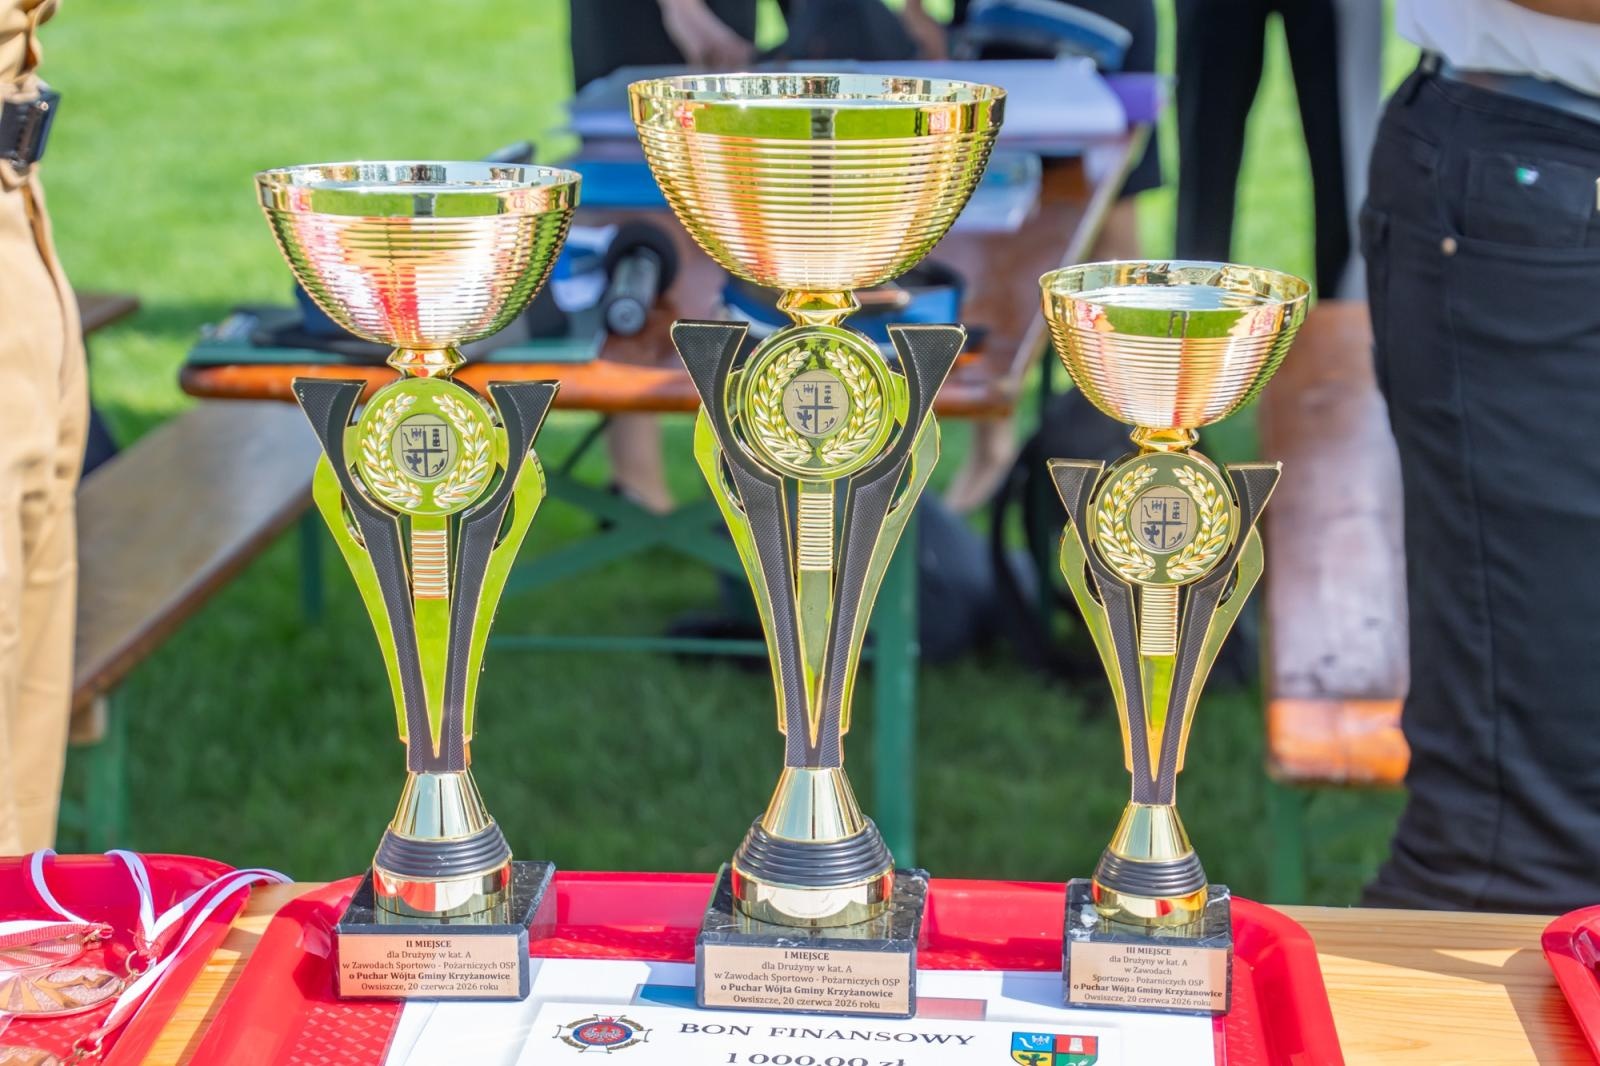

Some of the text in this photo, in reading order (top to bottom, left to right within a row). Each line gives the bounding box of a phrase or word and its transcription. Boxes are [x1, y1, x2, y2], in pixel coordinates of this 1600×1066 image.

[402, 951, 437, 960] Drużyny
[790, 952, 829, 961] MIEJSCE
[396, 962, 436, 971] Sportowo
[444, 962, 498, 971] Pożarniczych
[1123, 957, 1155, 966] Drużyny
[778, 963, 815, 973] Drużyny
[391, 972, 416, 982] Wójta
[418, 972, 447, 982] Gminy
[449, 972, 510, 982] Krzyżanowice
[724, 972, 769, 981] Zawodach
[771, 974, 814, 984] Sportowo
[822, 976, 880, 987] Pożarniczych
[1093, 974, 1129, 983] Sportowo
[1136, 977, 1186, 986] Pożarniczych
[361, 983, 406, 991] Owsiszcze,
[729, 984, 762, 992] Puchar
[765, 985, 792, 995] Wójta
[795, 986, 825, 996] Gminy
[827, 987, 893, 997] Krzyżanowice
[1112, 985, 1135, 993] Wójta
[1137, 987, 1163, 995] Gminy
[1165, 988, 1222, 997] Krzyżanowice
[734, 996, 780, 1005] Owsiszcze,
[680, 1023, 975, 1045] BON FINANSOWY
